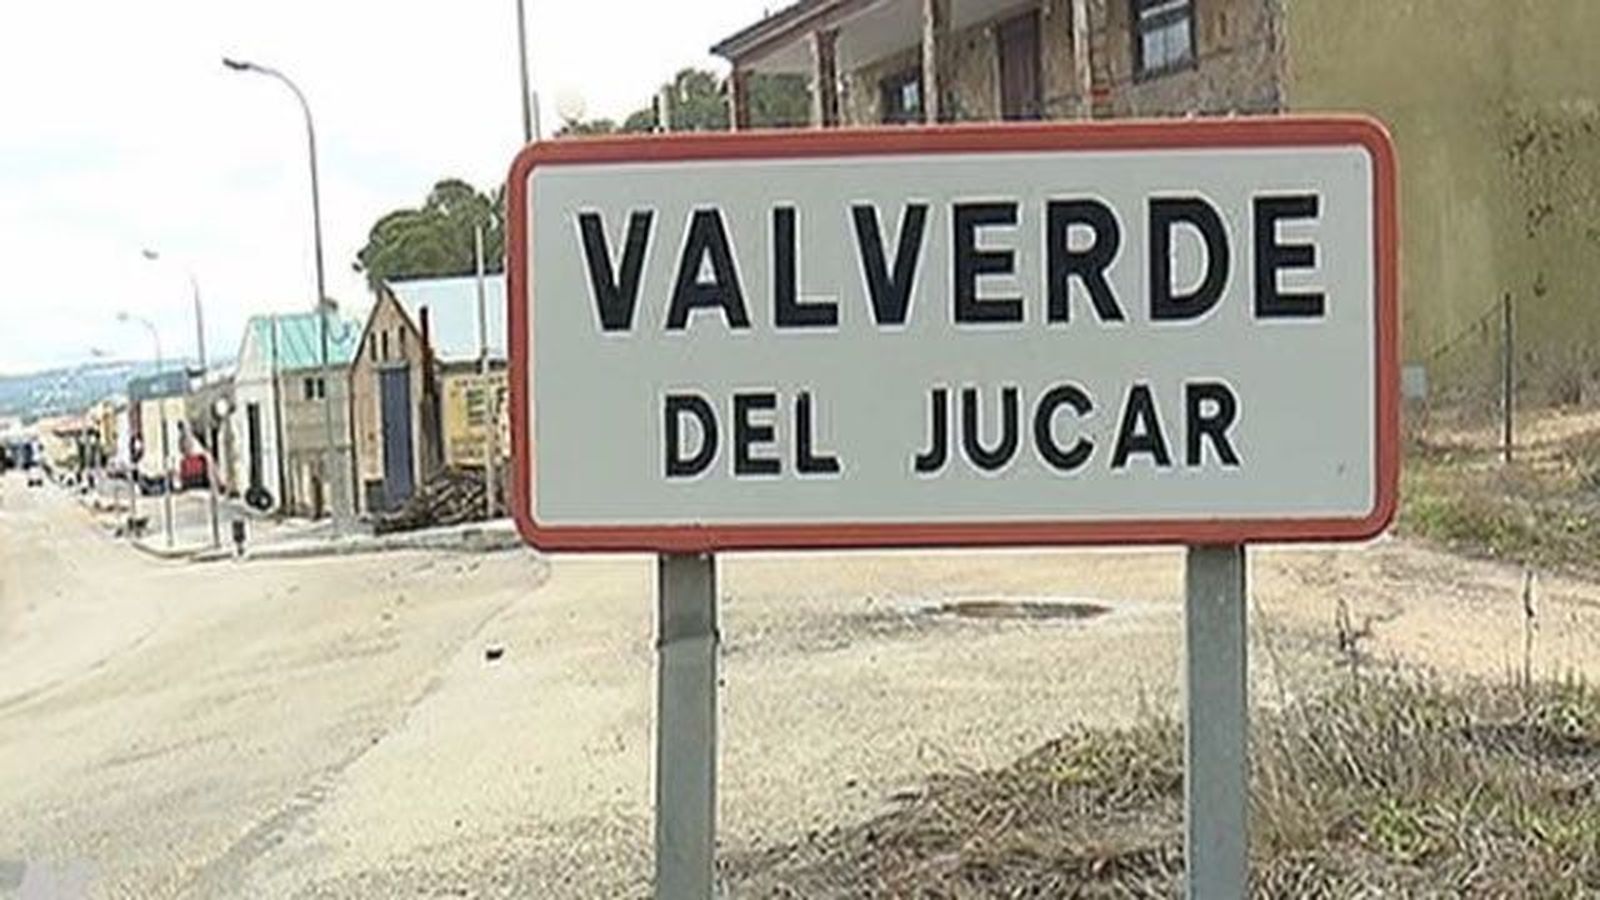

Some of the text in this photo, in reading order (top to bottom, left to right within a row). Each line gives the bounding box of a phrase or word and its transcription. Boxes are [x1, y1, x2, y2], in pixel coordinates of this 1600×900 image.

[578, 194, 1326, 332] VALVERDE
[664, 382, 1240, 477] DEL JUCAR
